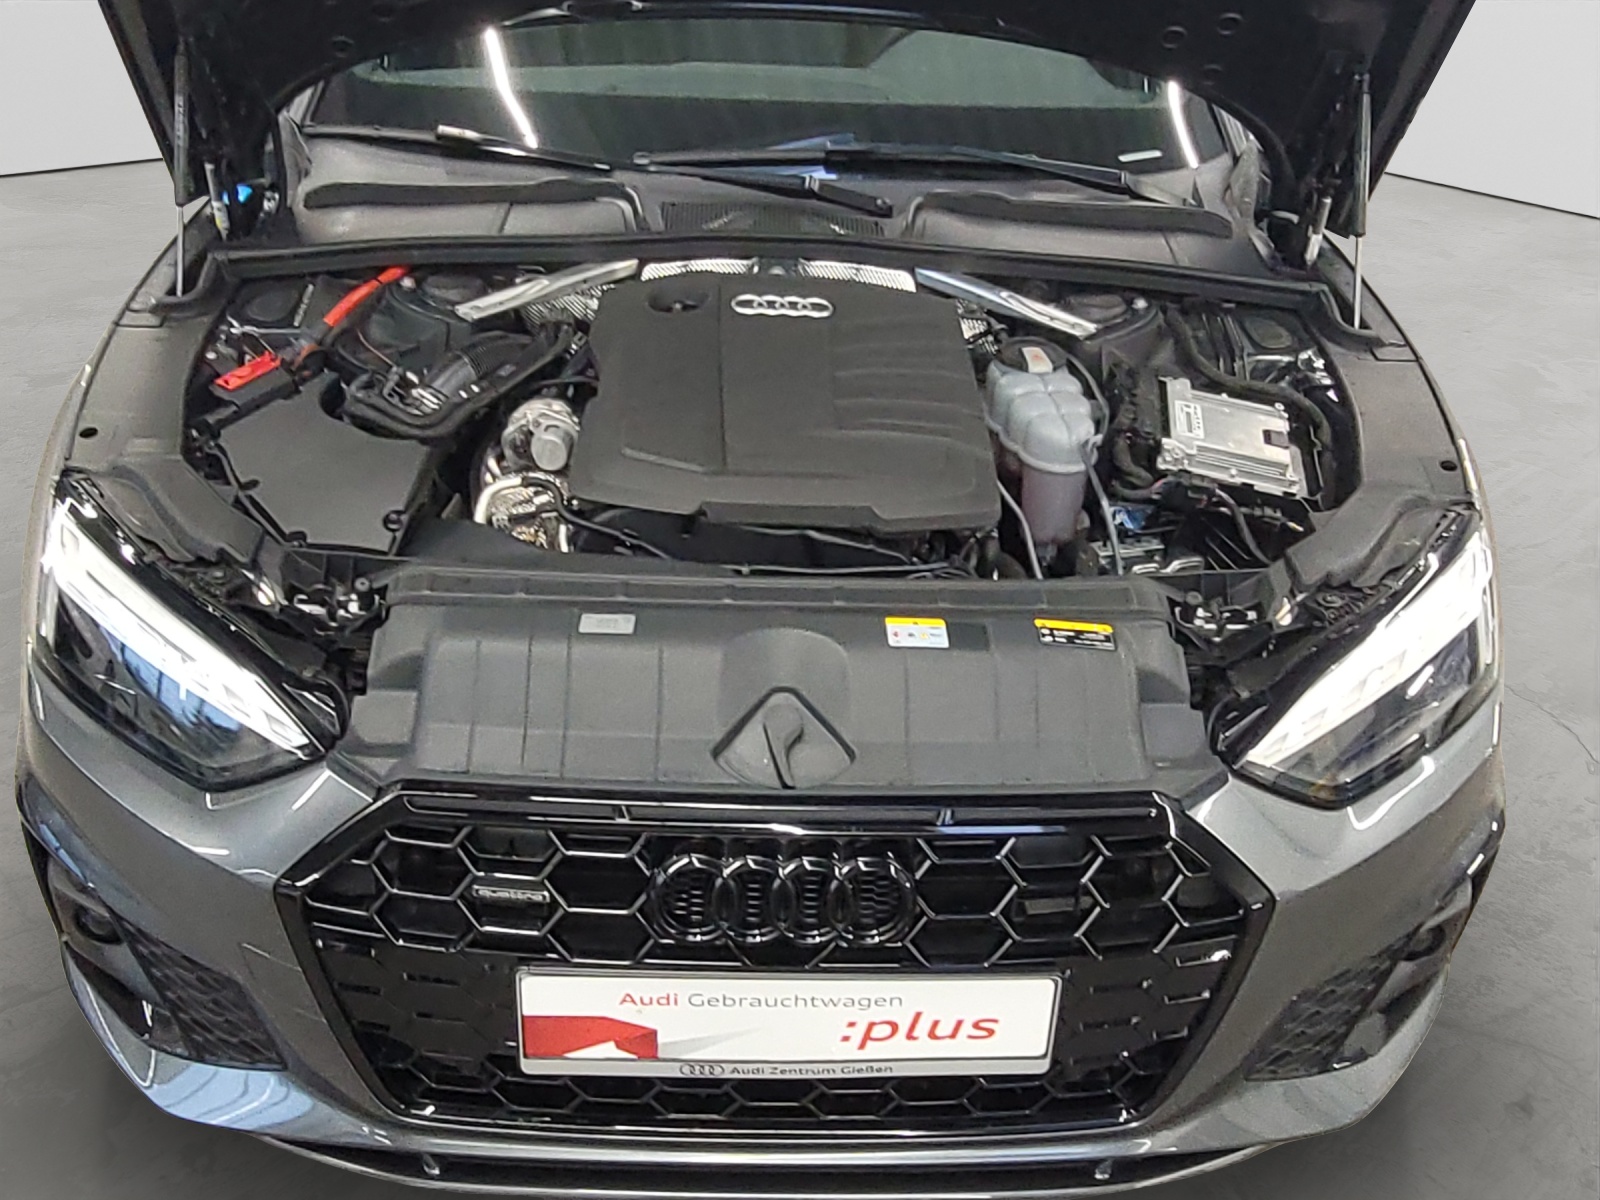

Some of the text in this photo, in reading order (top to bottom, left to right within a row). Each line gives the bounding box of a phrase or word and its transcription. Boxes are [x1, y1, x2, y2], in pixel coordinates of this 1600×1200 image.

[619, 993, 903, 1011] Audi Gebrauchtwagen
[729, 1066, 765, 1075] Audi
[768, 1066, 836, 1075] Zentrum
